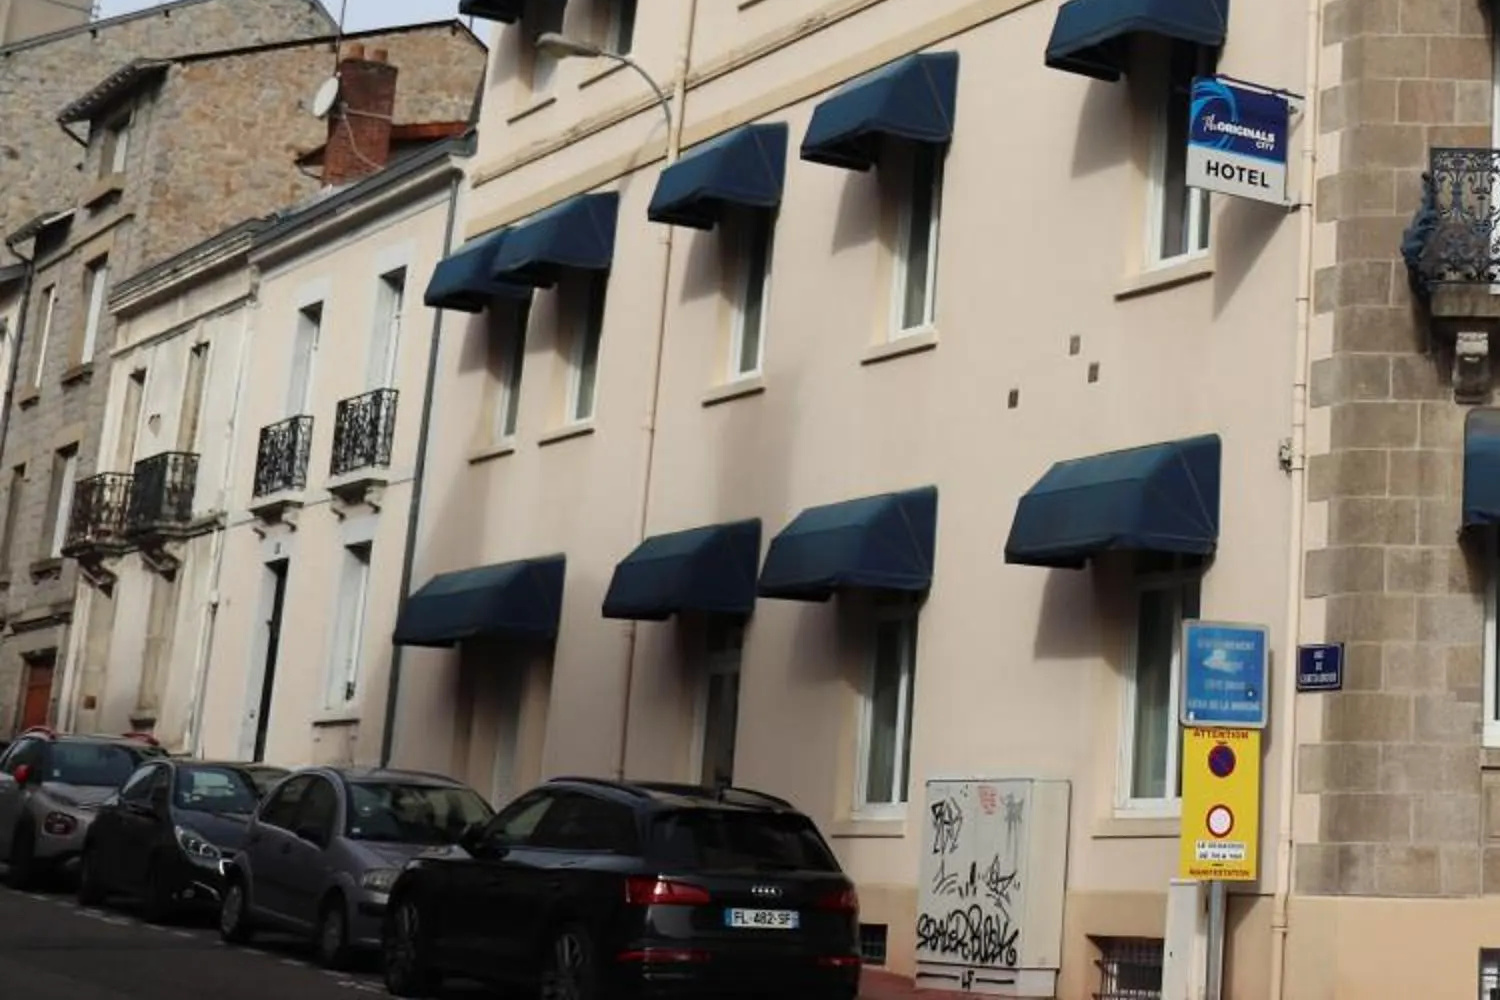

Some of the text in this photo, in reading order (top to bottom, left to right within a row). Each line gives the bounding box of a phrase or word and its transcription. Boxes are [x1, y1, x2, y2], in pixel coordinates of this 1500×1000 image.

[1216, 120, 1276, 143] ORIGINALS
[1255, 140, 1275, 151] CITY
[1206, 159, 1270, 189] HOTEL
[1193, 729, 1249, 740] ATTENTION
